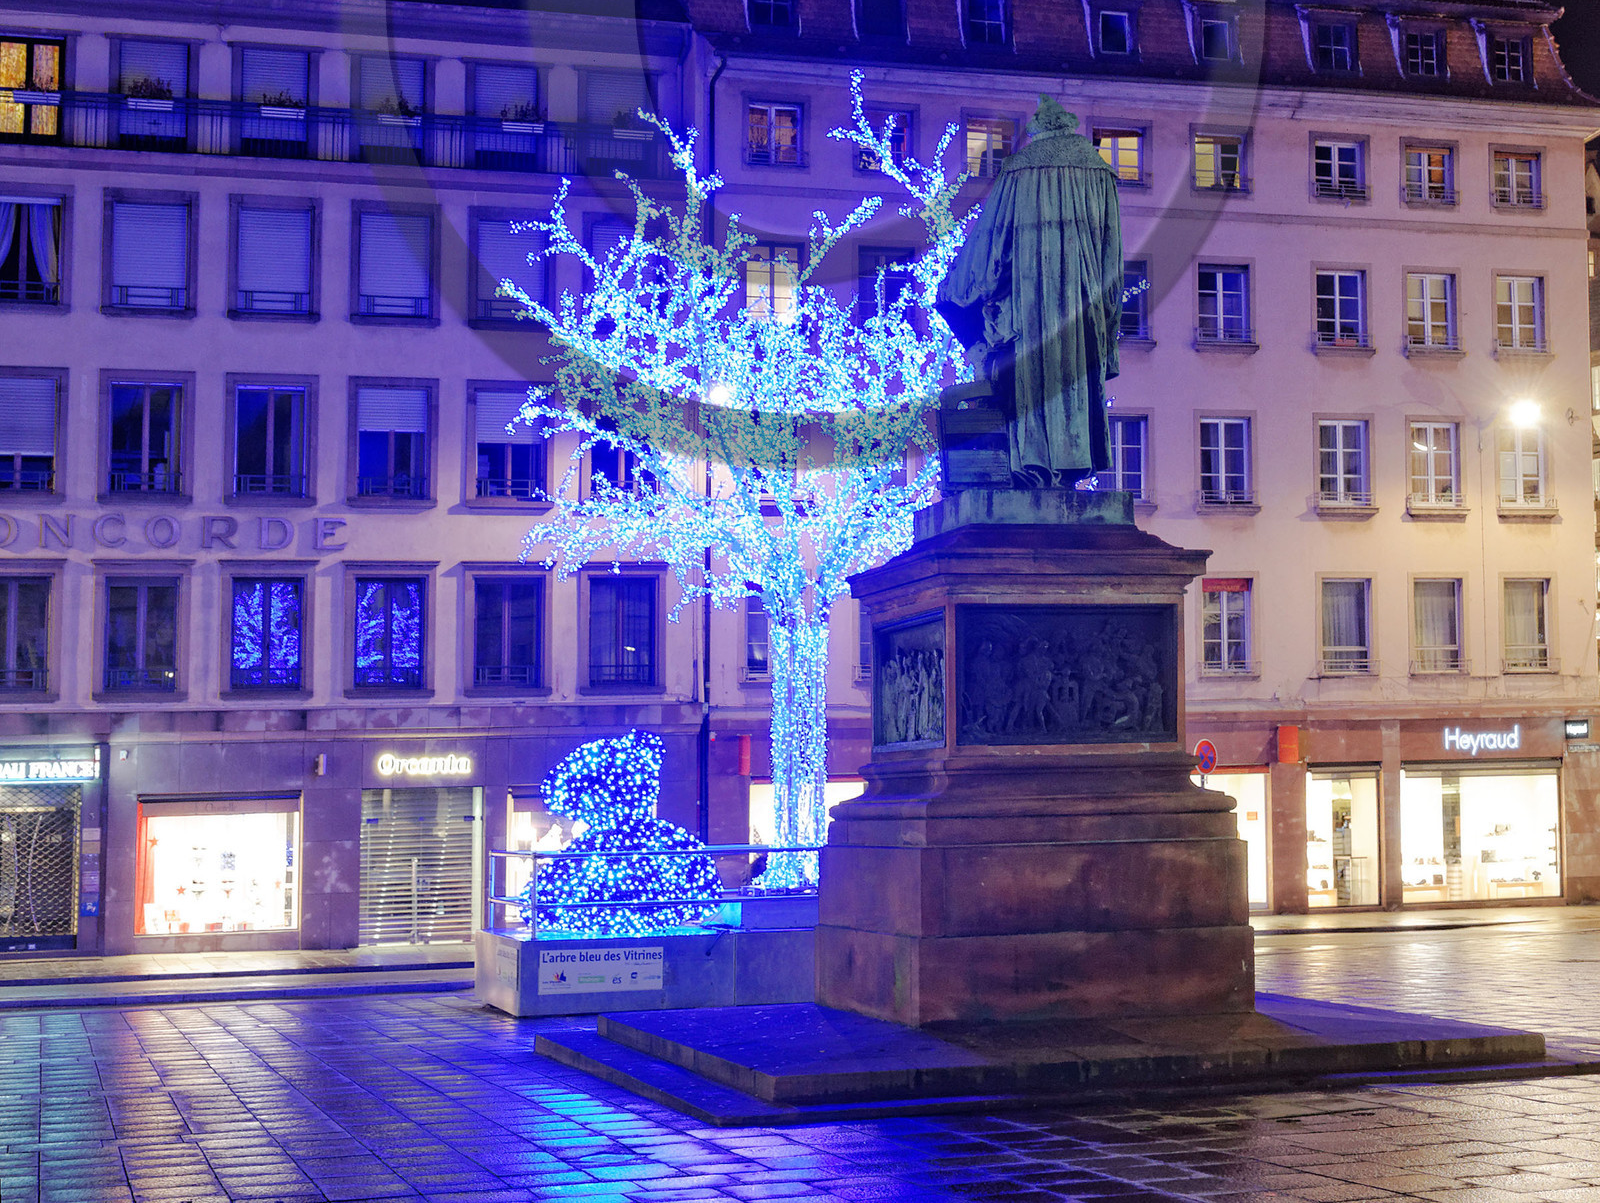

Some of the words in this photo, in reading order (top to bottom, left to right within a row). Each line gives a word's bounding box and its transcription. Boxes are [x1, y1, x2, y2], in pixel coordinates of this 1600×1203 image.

[1444, 724, 1519, 755] Heyraud
[28, 761, 94, 778] FRANCE
[542, 952, 577, 964] L'arbre
[579, 951, 601, 962] bleu
[603, 950, 621, 962] des
[624, 950, 662, 961] Vitrines
